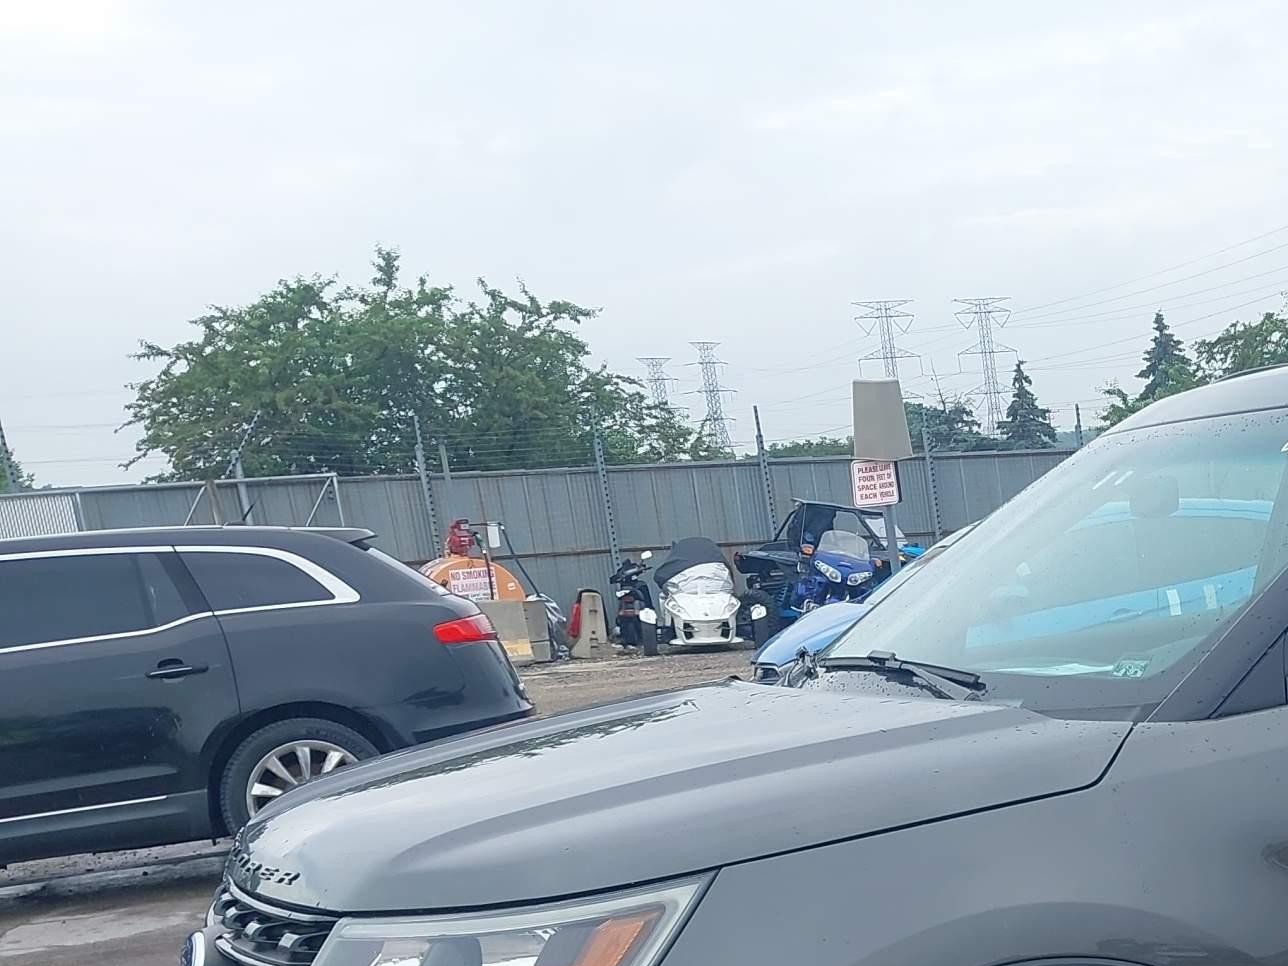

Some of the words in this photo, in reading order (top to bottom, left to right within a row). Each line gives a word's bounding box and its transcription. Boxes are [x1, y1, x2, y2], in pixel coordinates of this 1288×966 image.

[857, 465, 878, 474] PLEASE
[857, 483, 878, 491] SPACE
[451, 571, 461, 581] NO
[452, 581, 497, 593] FLAMMABE
